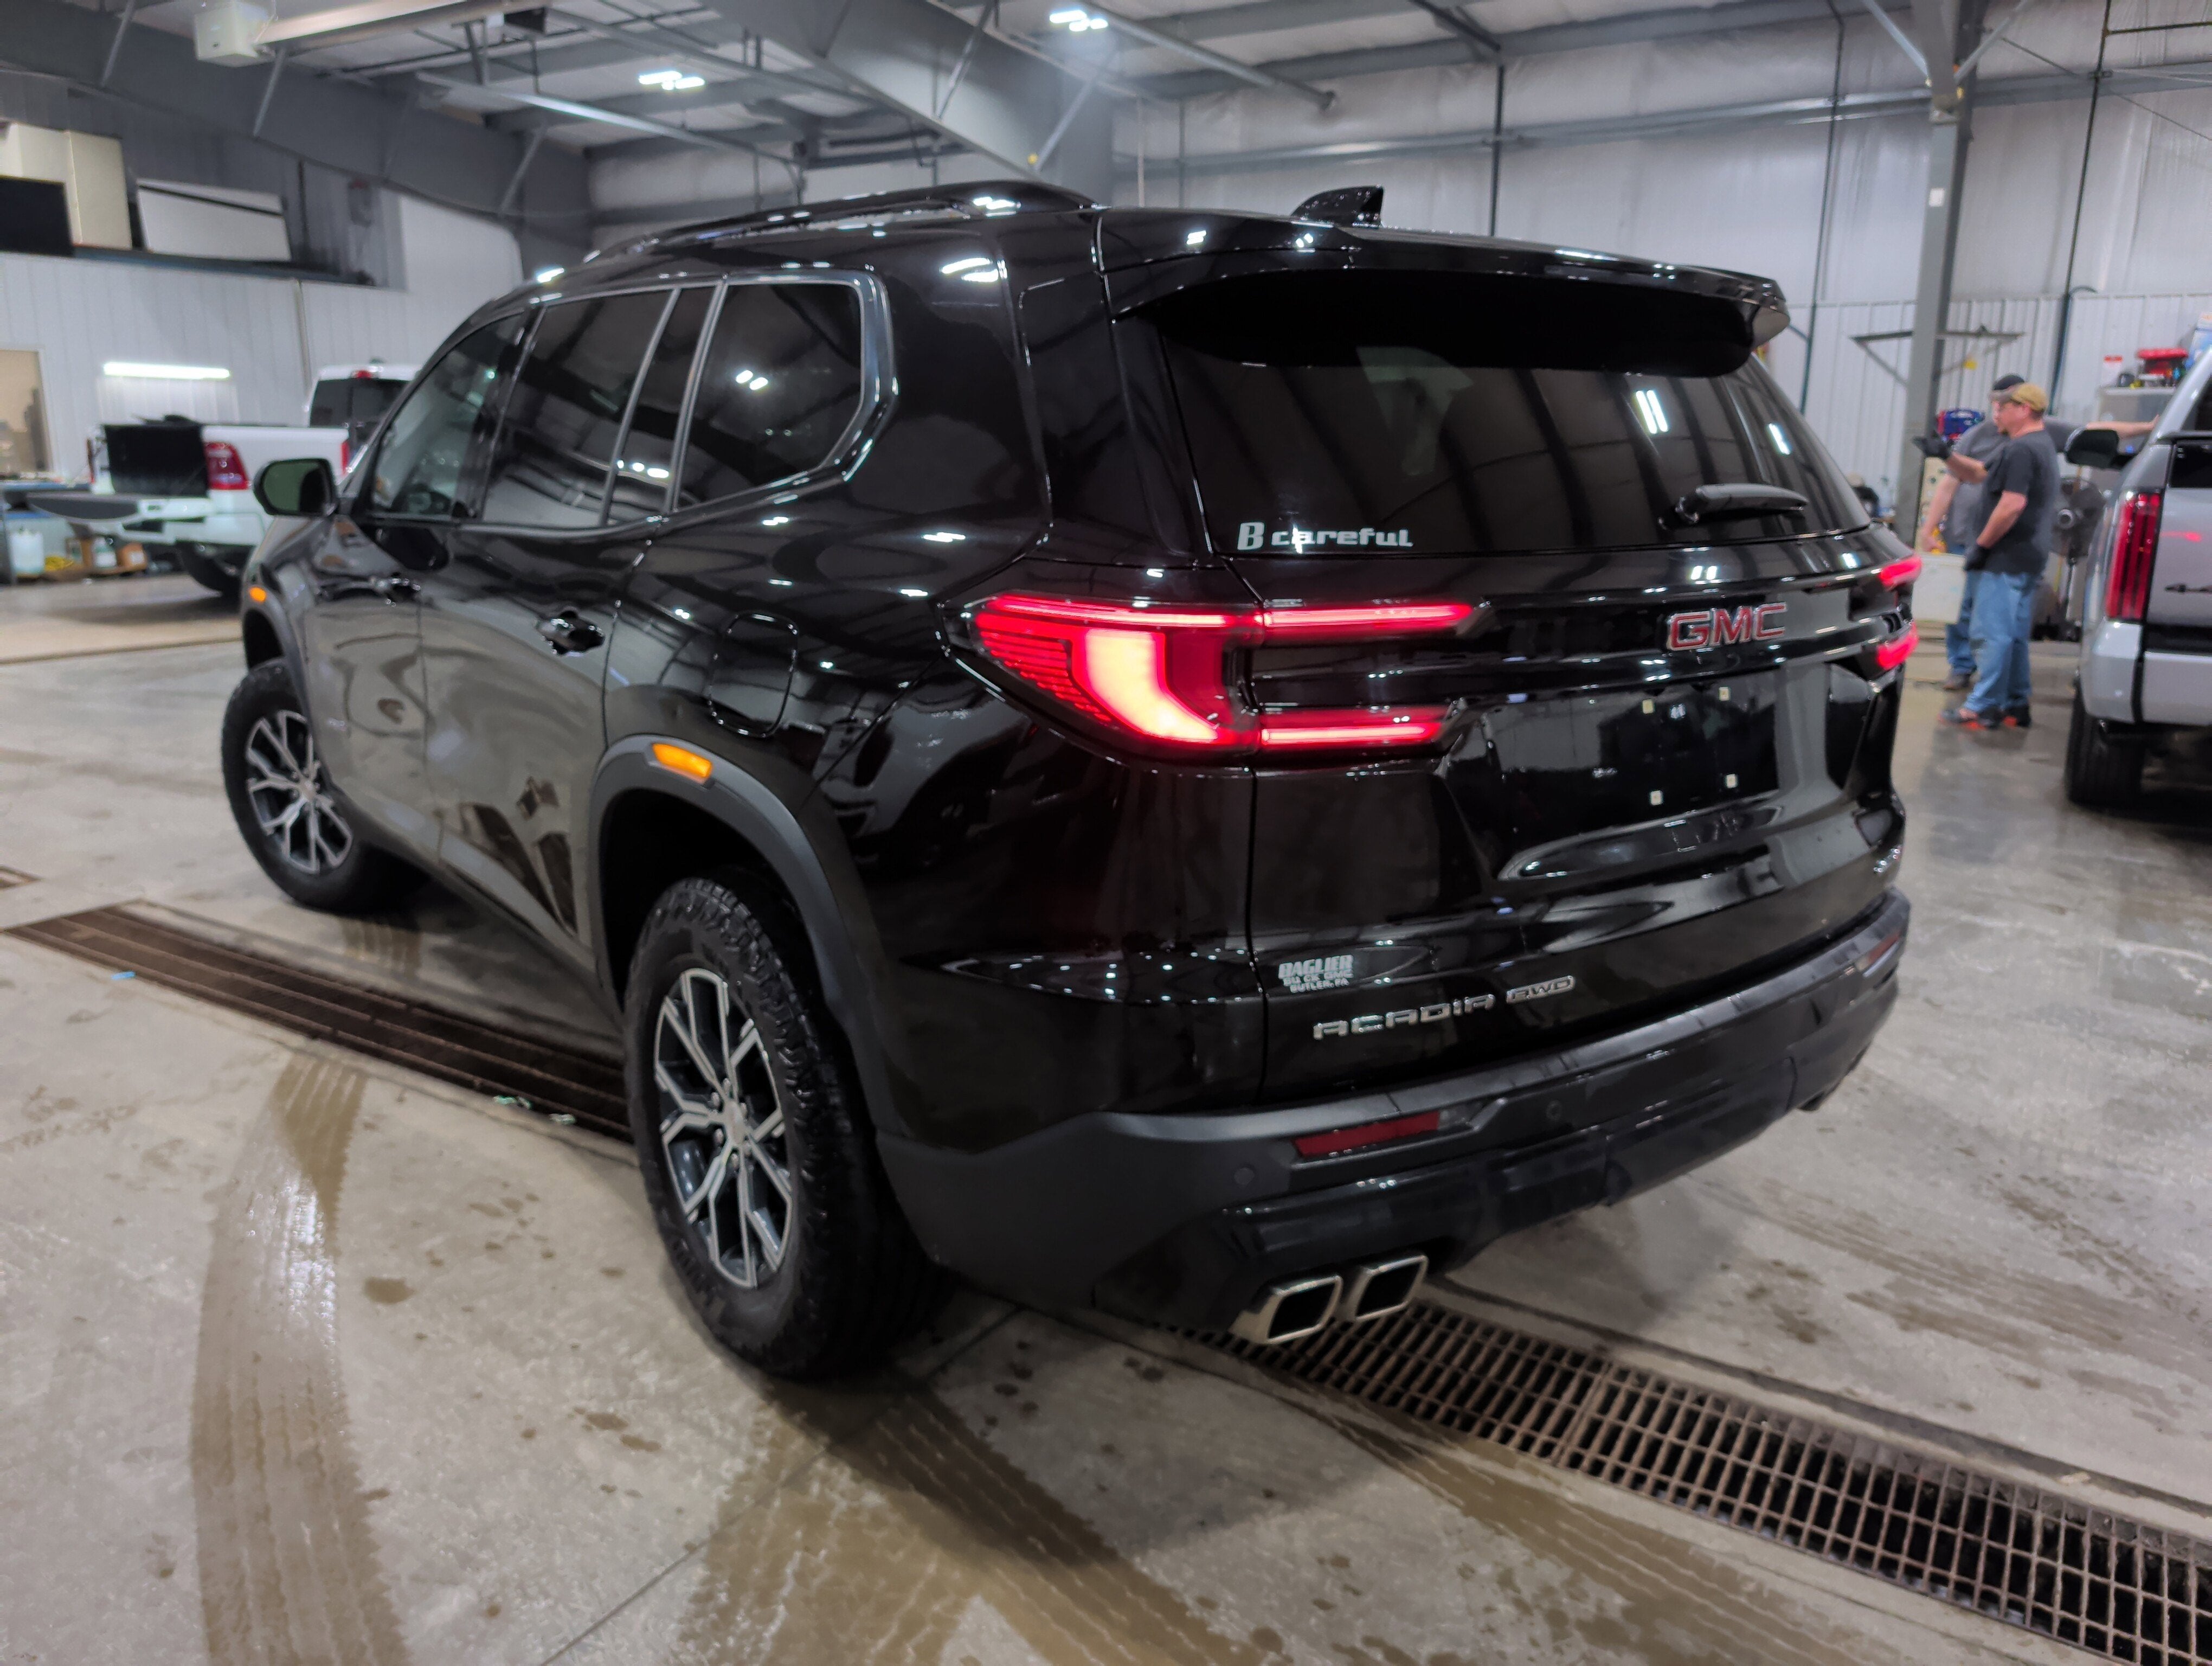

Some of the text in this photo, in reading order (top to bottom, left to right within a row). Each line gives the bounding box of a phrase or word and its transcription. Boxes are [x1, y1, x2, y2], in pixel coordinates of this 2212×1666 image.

[1237, 522, 1414, 550] B careful
[1667, 603, 1787, 651] GMC
[1278, 954, 1354, 979] BAGLIER
[1283, 974, 1320, 986] BUCK
[1313, 976, 1576, 1040] ACADIA AWD
